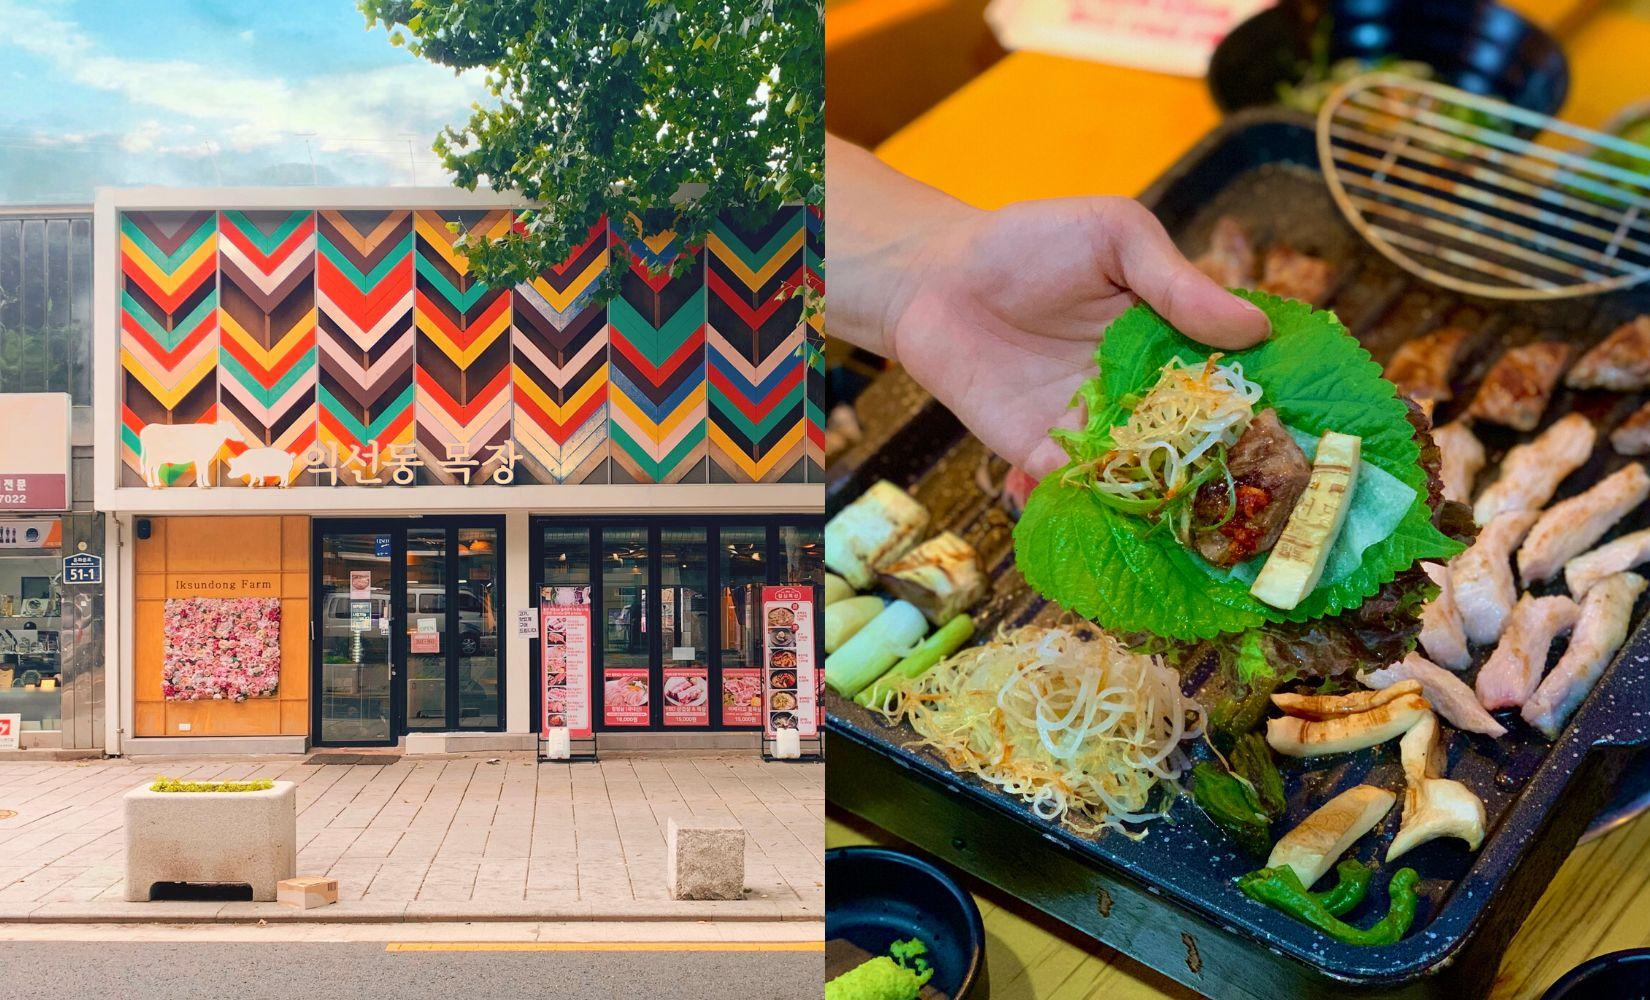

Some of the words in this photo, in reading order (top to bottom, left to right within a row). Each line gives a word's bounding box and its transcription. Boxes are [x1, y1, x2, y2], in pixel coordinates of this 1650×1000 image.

[304, 439, 425, 487] 익선동
[436, 439, 524, 486] 목장
[70, 568, 94, 580] 51-1
[176, 580, 236, 590] Iksundong
[241, 579, 271, 589] Farm
